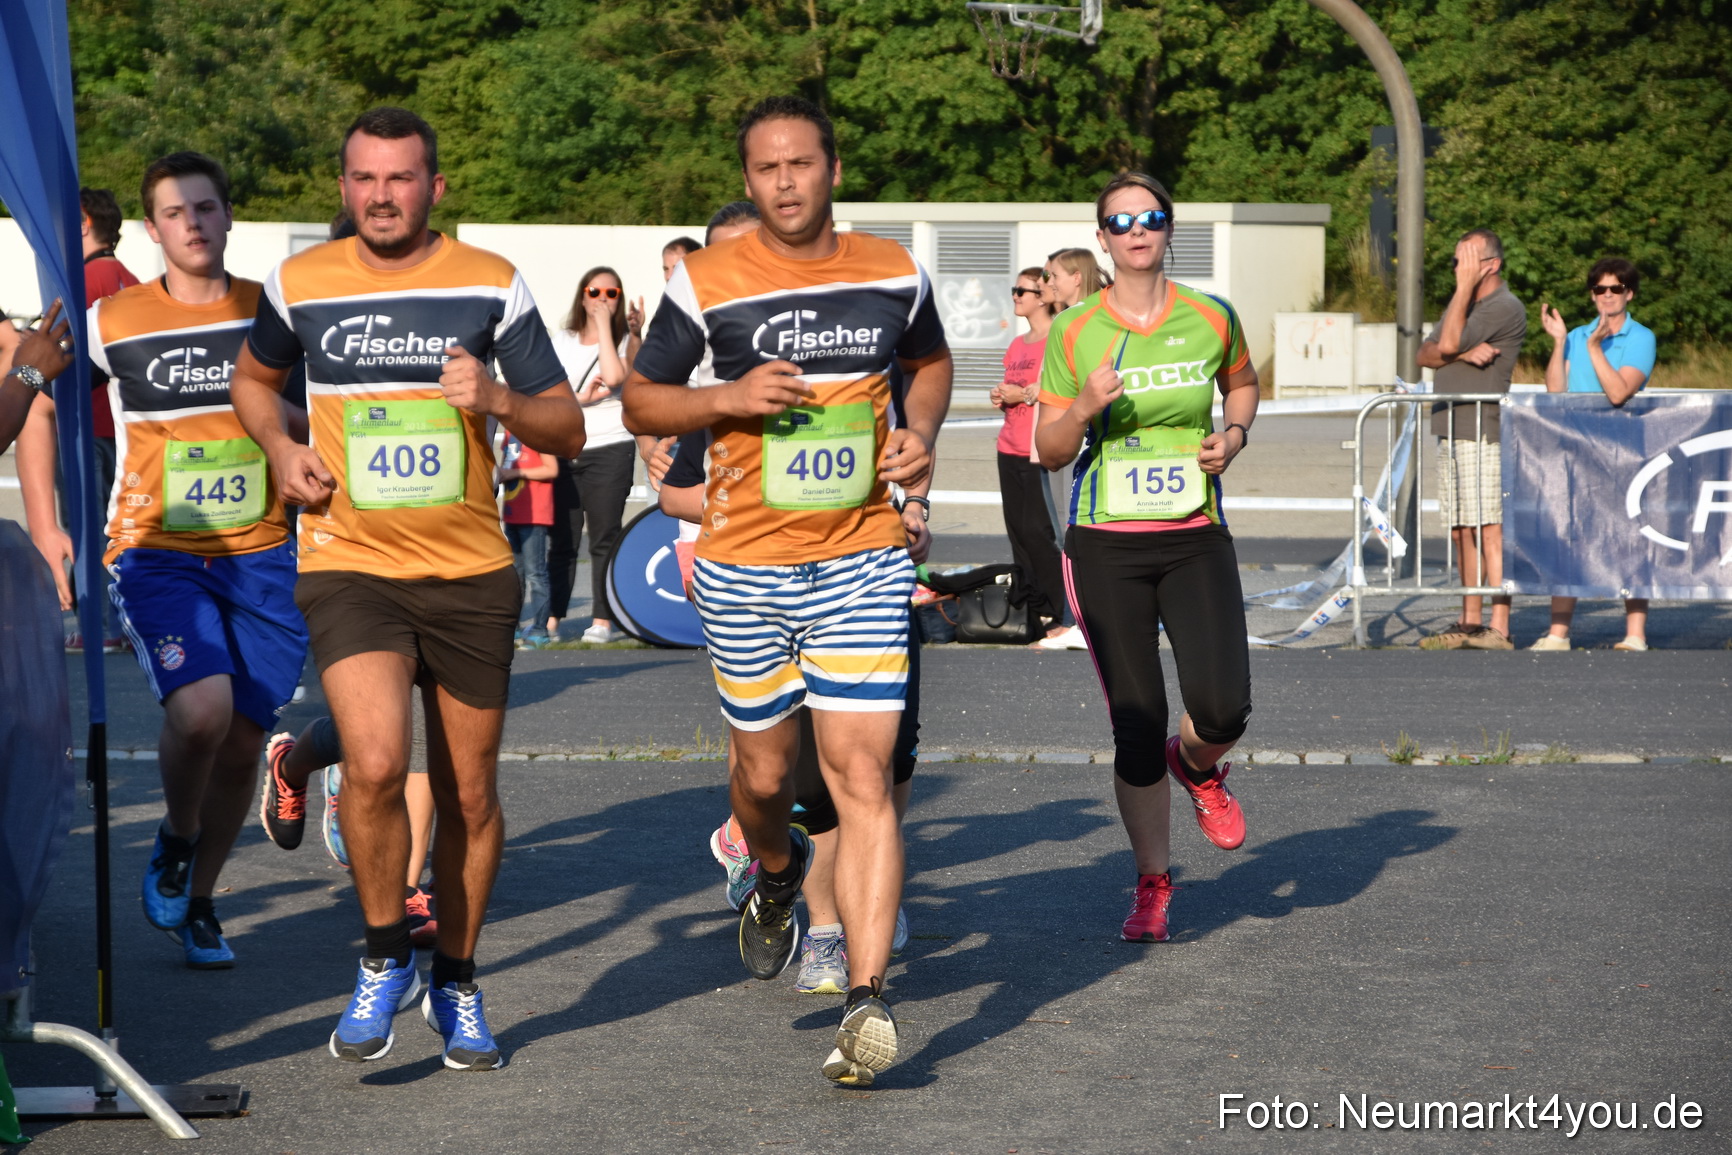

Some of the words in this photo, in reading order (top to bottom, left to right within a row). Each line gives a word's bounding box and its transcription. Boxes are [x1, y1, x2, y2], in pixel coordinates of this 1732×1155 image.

[343, 332, 457, 354] Fischer
[778, 325, 882, 352] Fischer
[355, 356, 449, 366] AUTOMOBILE
[790, 346, 877, 361] AUTOMOBILE
[168, 361, 236, 384] Fisch
[1112, 359, 1209, 394] OCK
[179, 382, 230, 393] AUTOMO
[368, 443, 441, 478] 408
[786, 446, 856, 481] 409
[185, 474, 247, 506] 443
[392, 485, 434, 493] Krauberger
[1125, 466, 1185, 494] 155
